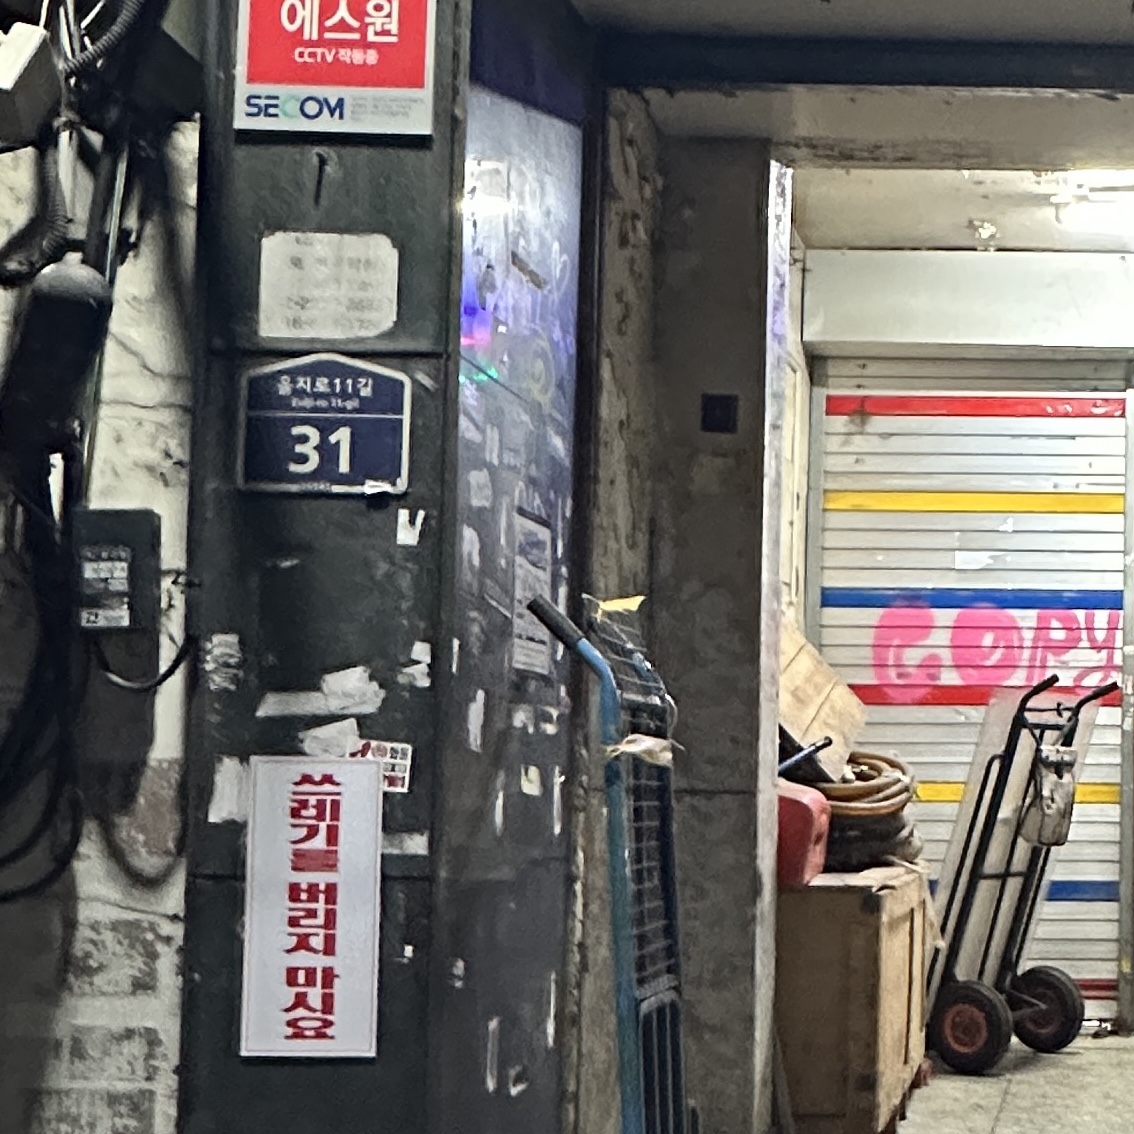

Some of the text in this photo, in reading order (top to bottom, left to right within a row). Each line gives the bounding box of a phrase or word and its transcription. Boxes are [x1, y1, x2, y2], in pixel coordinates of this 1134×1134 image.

[280, 0, 399, 43] 에스원
[294, 47, 336, 63] CCTV
[245, 94, 345, 120] SECOM
[277, 374, 374, 398] 을지로11길
[287, 424, 352, 475] 31
[289, 774, 342, 873] 쓰레기를
[283, 882, 338, 957] 버리지
